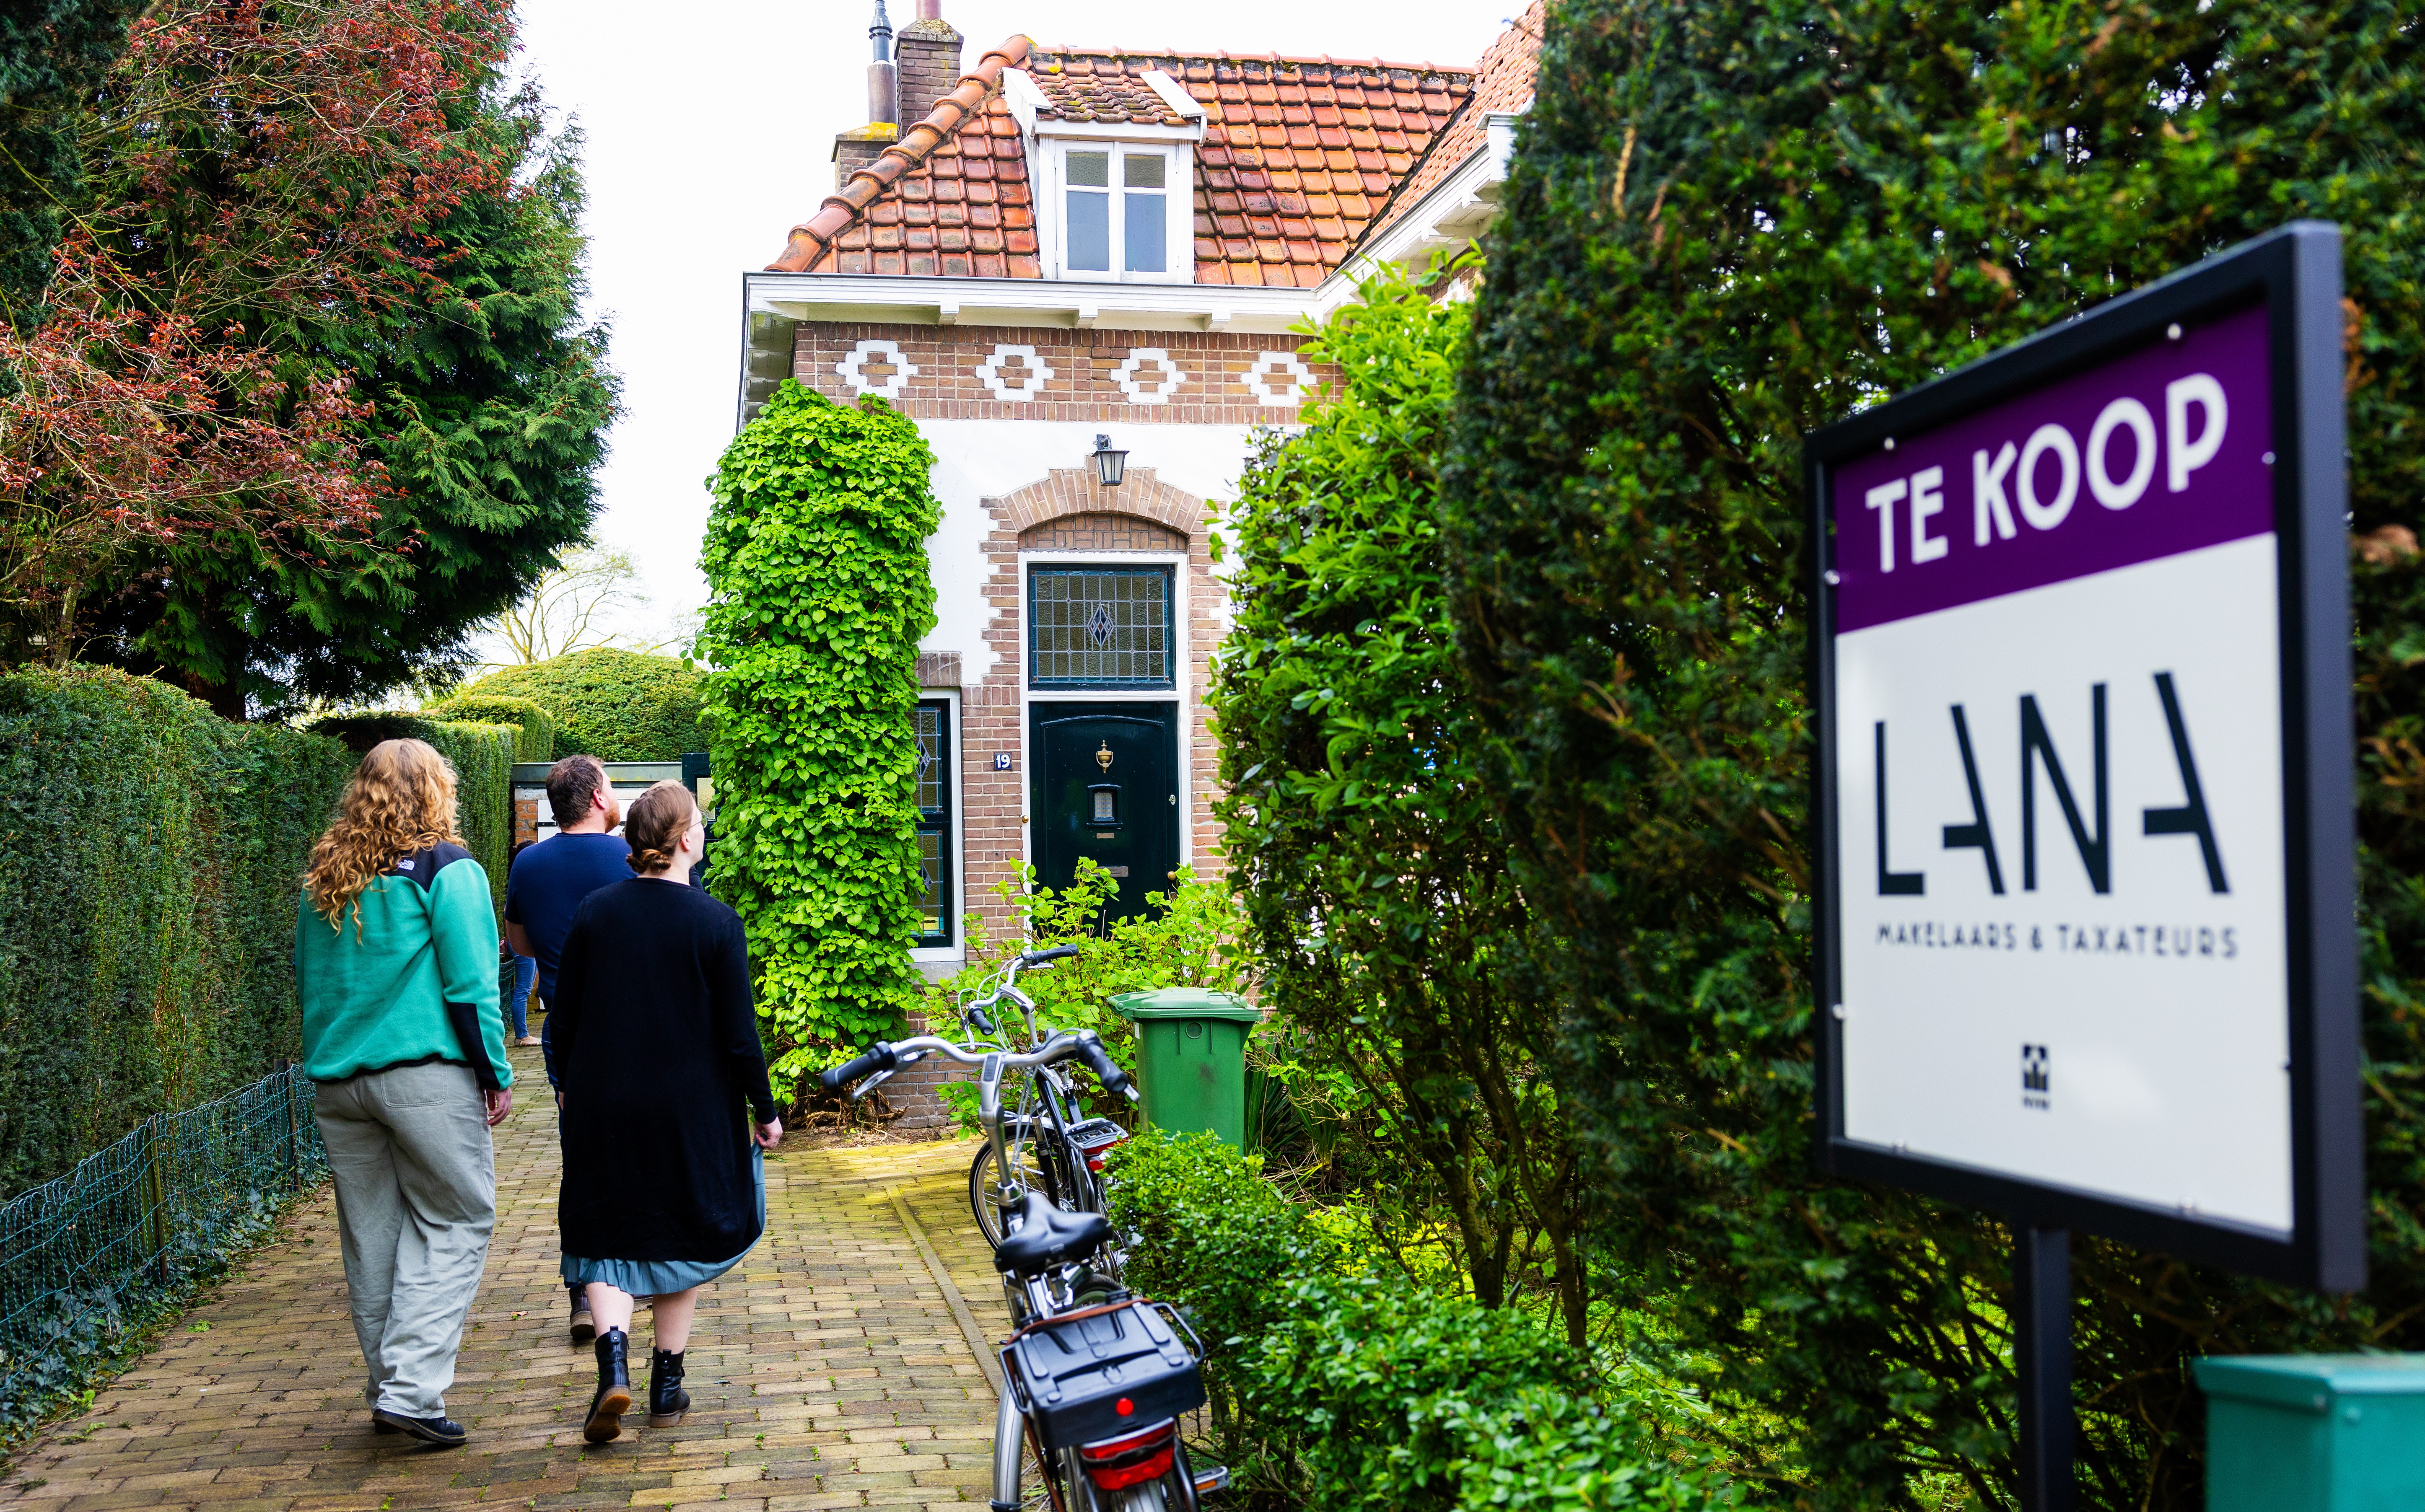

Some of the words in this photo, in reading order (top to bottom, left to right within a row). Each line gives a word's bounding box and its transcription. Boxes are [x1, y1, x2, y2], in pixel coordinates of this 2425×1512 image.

[1865, 465, 1949, 573] TE
[1972, 373, 2228, 547] KOOP
[996, 754, 1010, 768] 19
[1875, 671, 2231, 897] LANA
[1874, 920, 2018, 952] MAKELAARS
[2028, 924, 2044, 952] &
[2055, 923, 2239, 960] TAXATEURS
